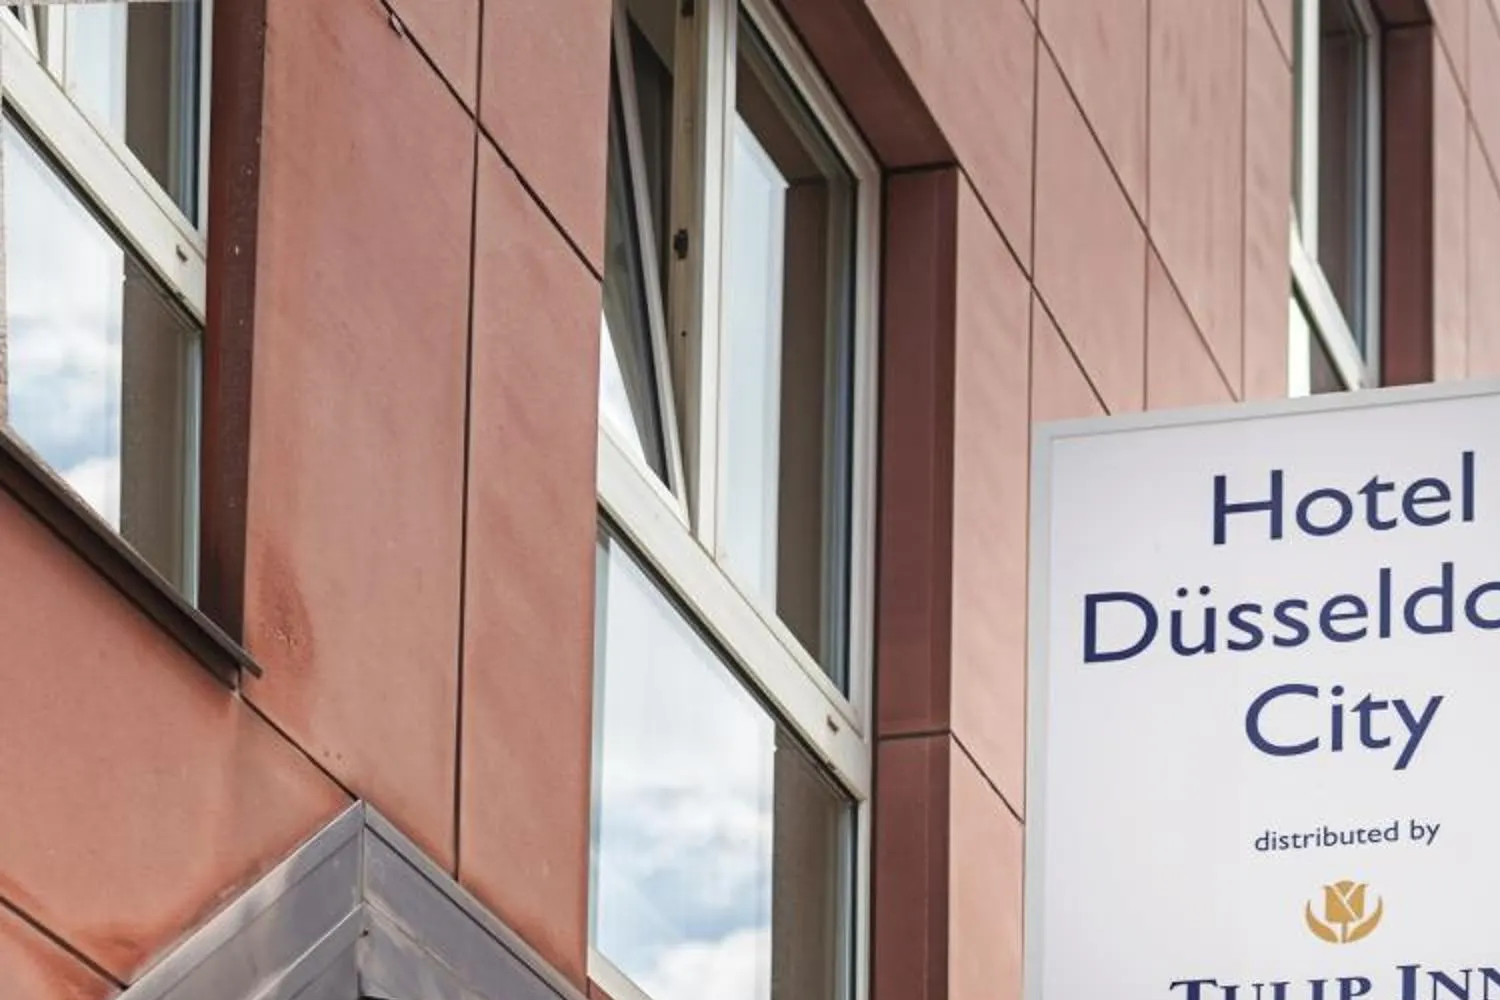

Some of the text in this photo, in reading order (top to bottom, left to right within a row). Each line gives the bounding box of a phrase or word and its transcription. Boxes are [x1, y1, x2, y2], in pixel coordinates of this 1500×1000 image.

[1213, 450, 1475, 546] Hotel
[1245, 683, 1444, 771] City
[1254, 819, 1441, 852] distributed by
